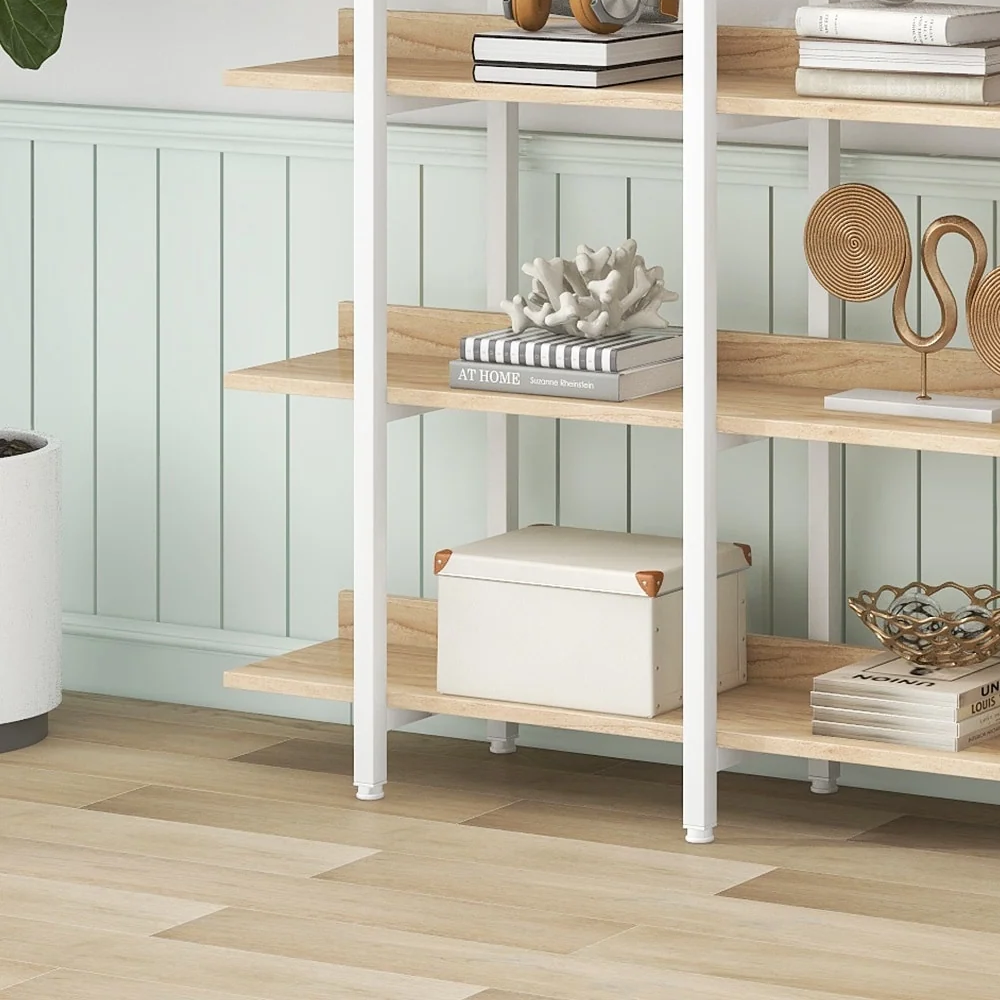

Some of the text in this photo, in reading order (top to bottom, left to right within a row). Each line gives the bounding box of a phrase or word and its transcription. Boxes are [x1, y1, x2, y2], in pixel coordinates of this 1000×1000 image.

[457, 368, 521, 385] AT HOME
[529, 377, 595, 389] Suzanne Rheinstein
[852, 674, 936, 687] UNION
[971, 696, 996, 714] LOUIS
